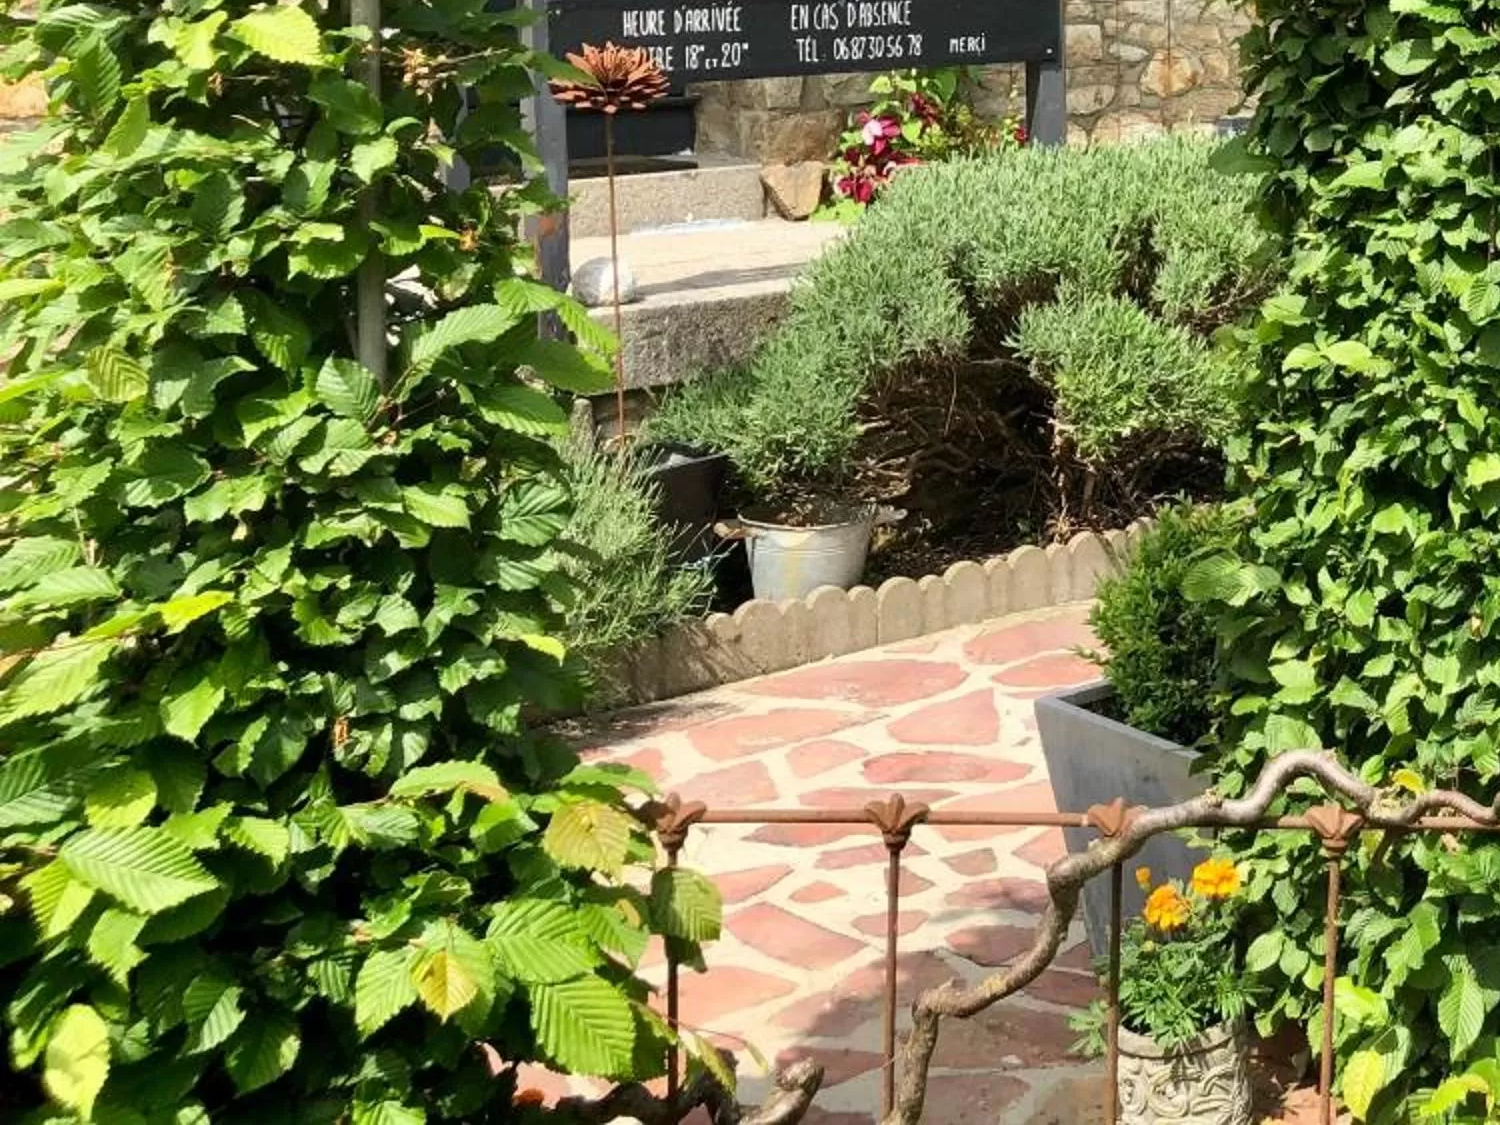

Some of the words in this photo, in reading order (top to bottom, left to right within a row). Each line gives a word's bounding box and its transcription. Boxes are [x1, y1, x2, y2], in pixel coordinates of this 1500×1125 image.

[622, 9, 667, 38] HEURE
[790, 4, 809, 31] EN
[813, 1, 839, 31] CAS
[642, 45, 675, 71] TRE
